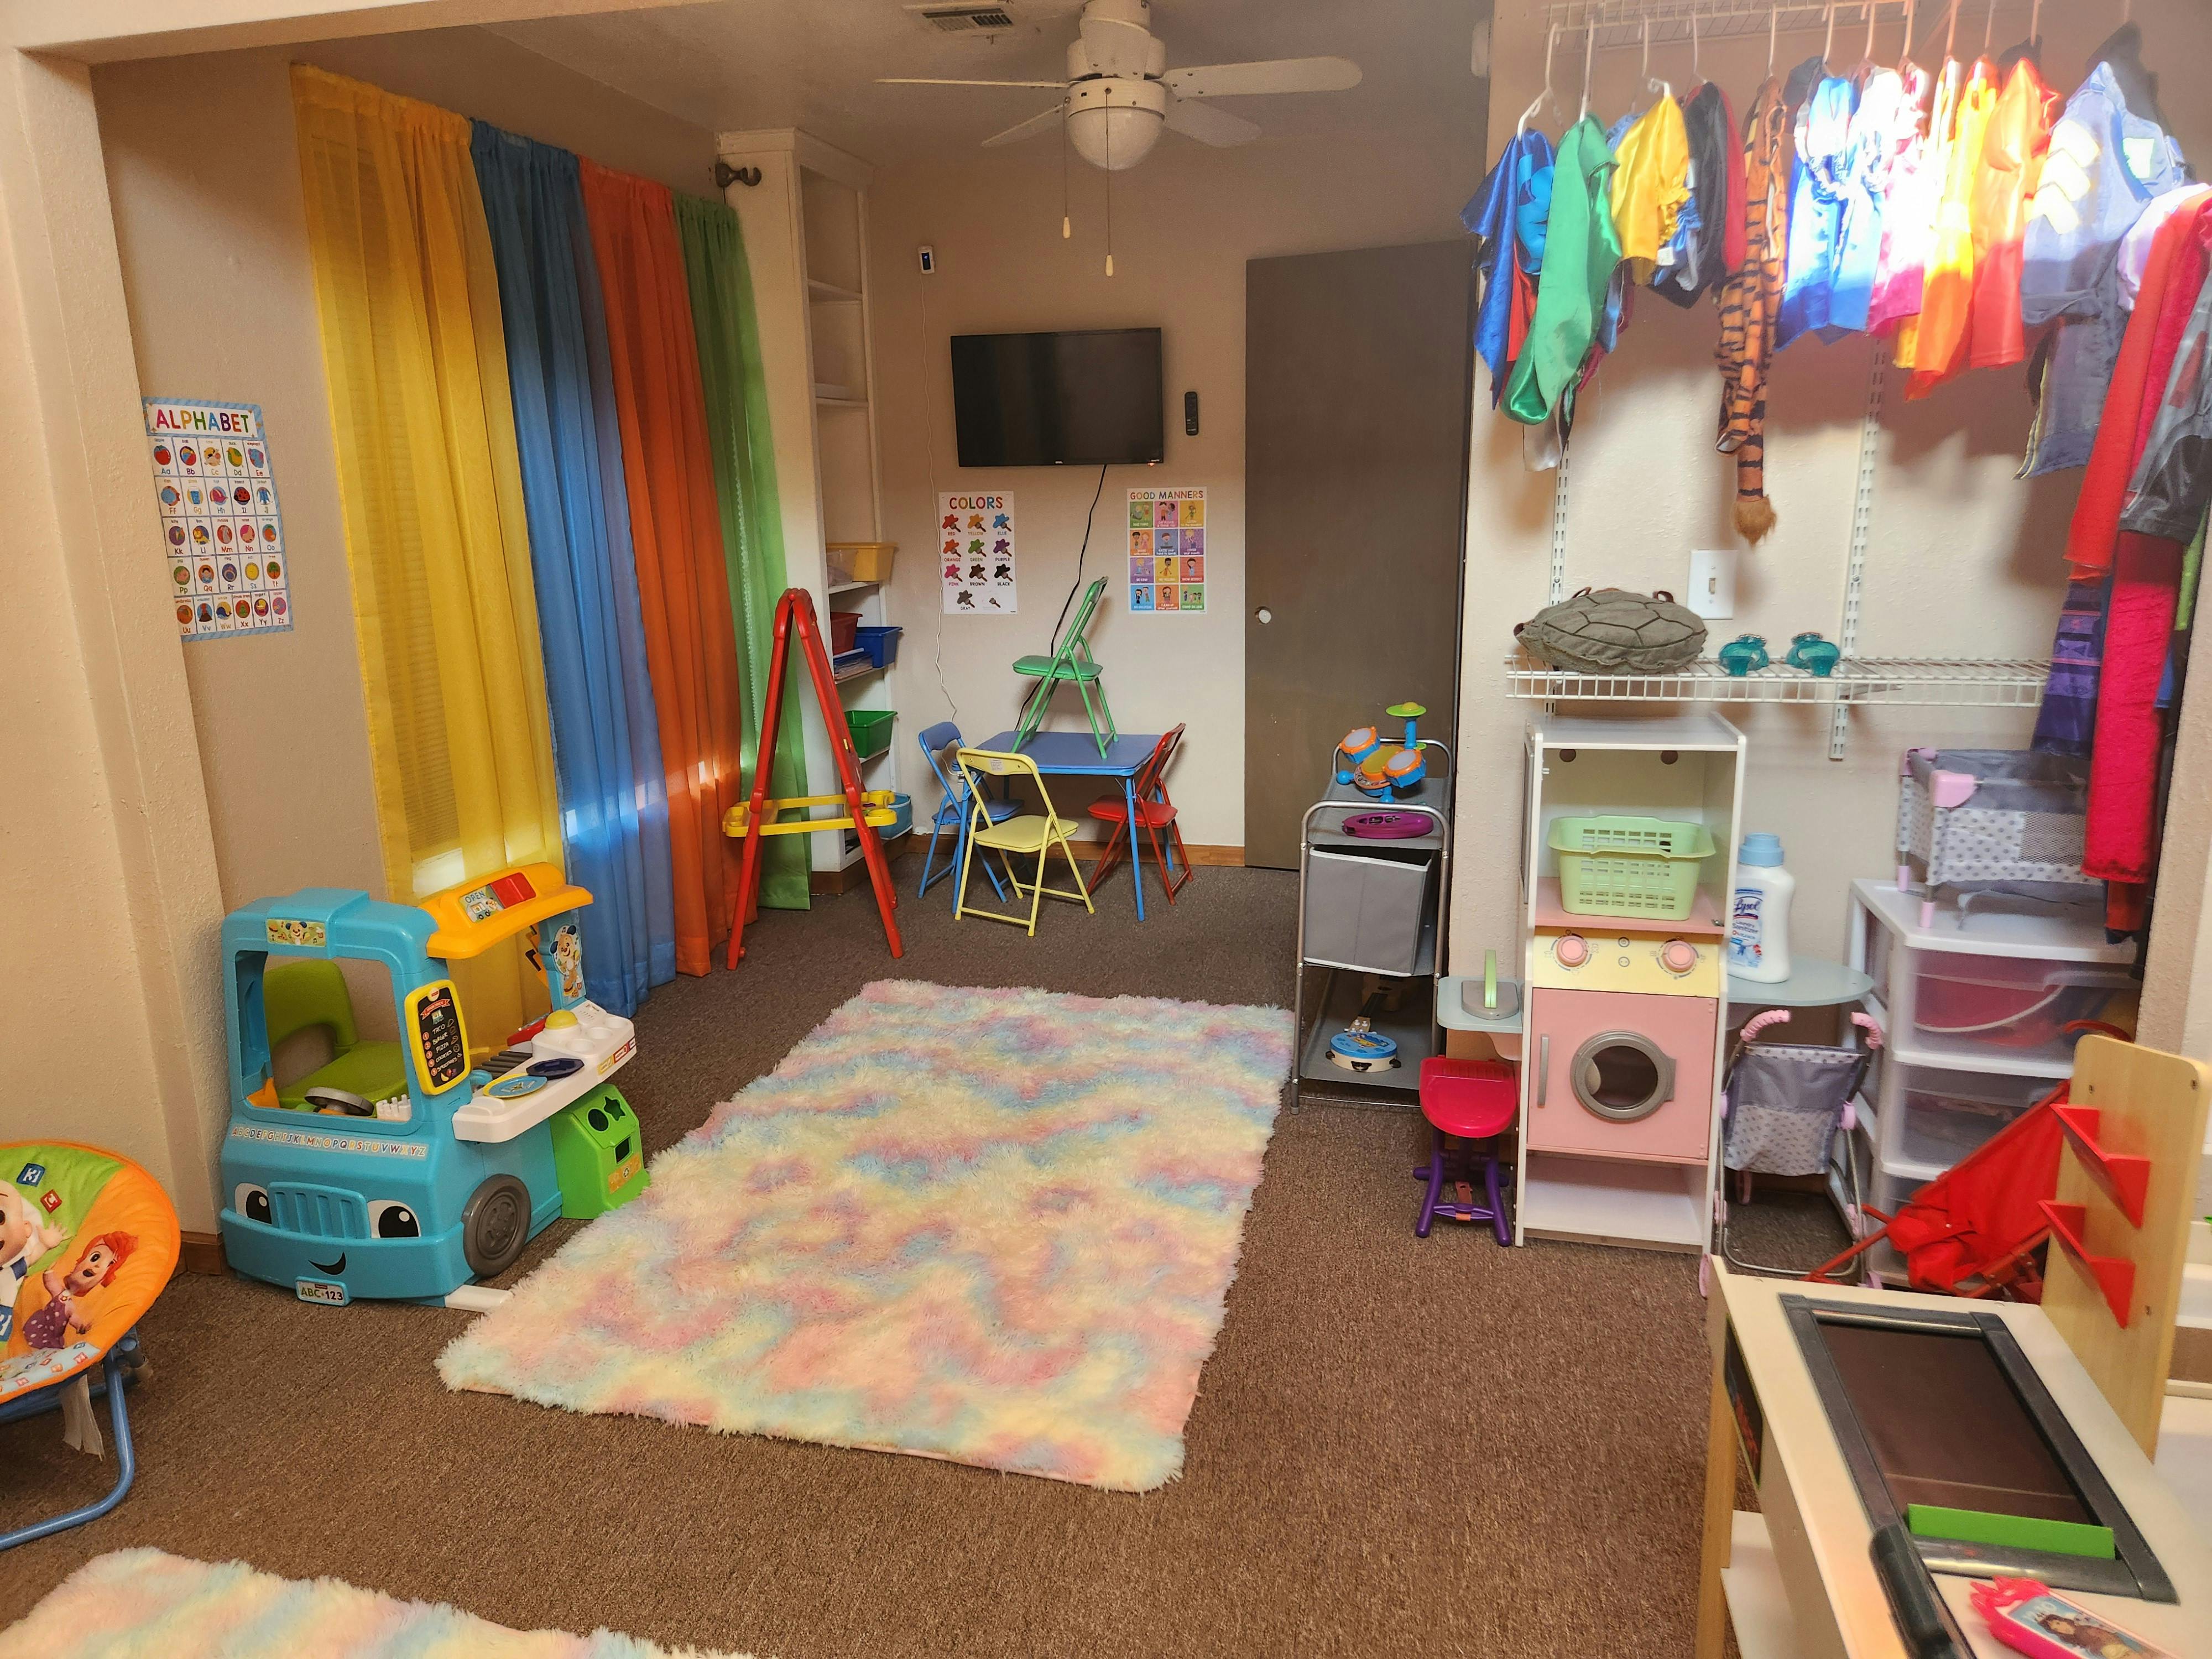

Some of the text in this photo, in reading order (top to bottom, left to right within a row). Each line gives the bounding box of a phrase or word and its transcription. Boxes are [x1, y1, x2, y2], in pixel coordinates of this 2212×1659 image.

[156, 409, 249, 432] ALPHABET
[1130, 491, 1203, 500] GOOD MANNERS
[949, 497, 1003, 509] COLORS
[465, 890, 485, 902] OPEN
[1733, 899, 1760, 914] Lysol
[432, 1024, 445, 1034] TACO
[436, 1042, 449, 1053] PIZZA
[436, 1050, 452, 1063] COOKIES
[301, 1287, 343, 1301] ABC 123
